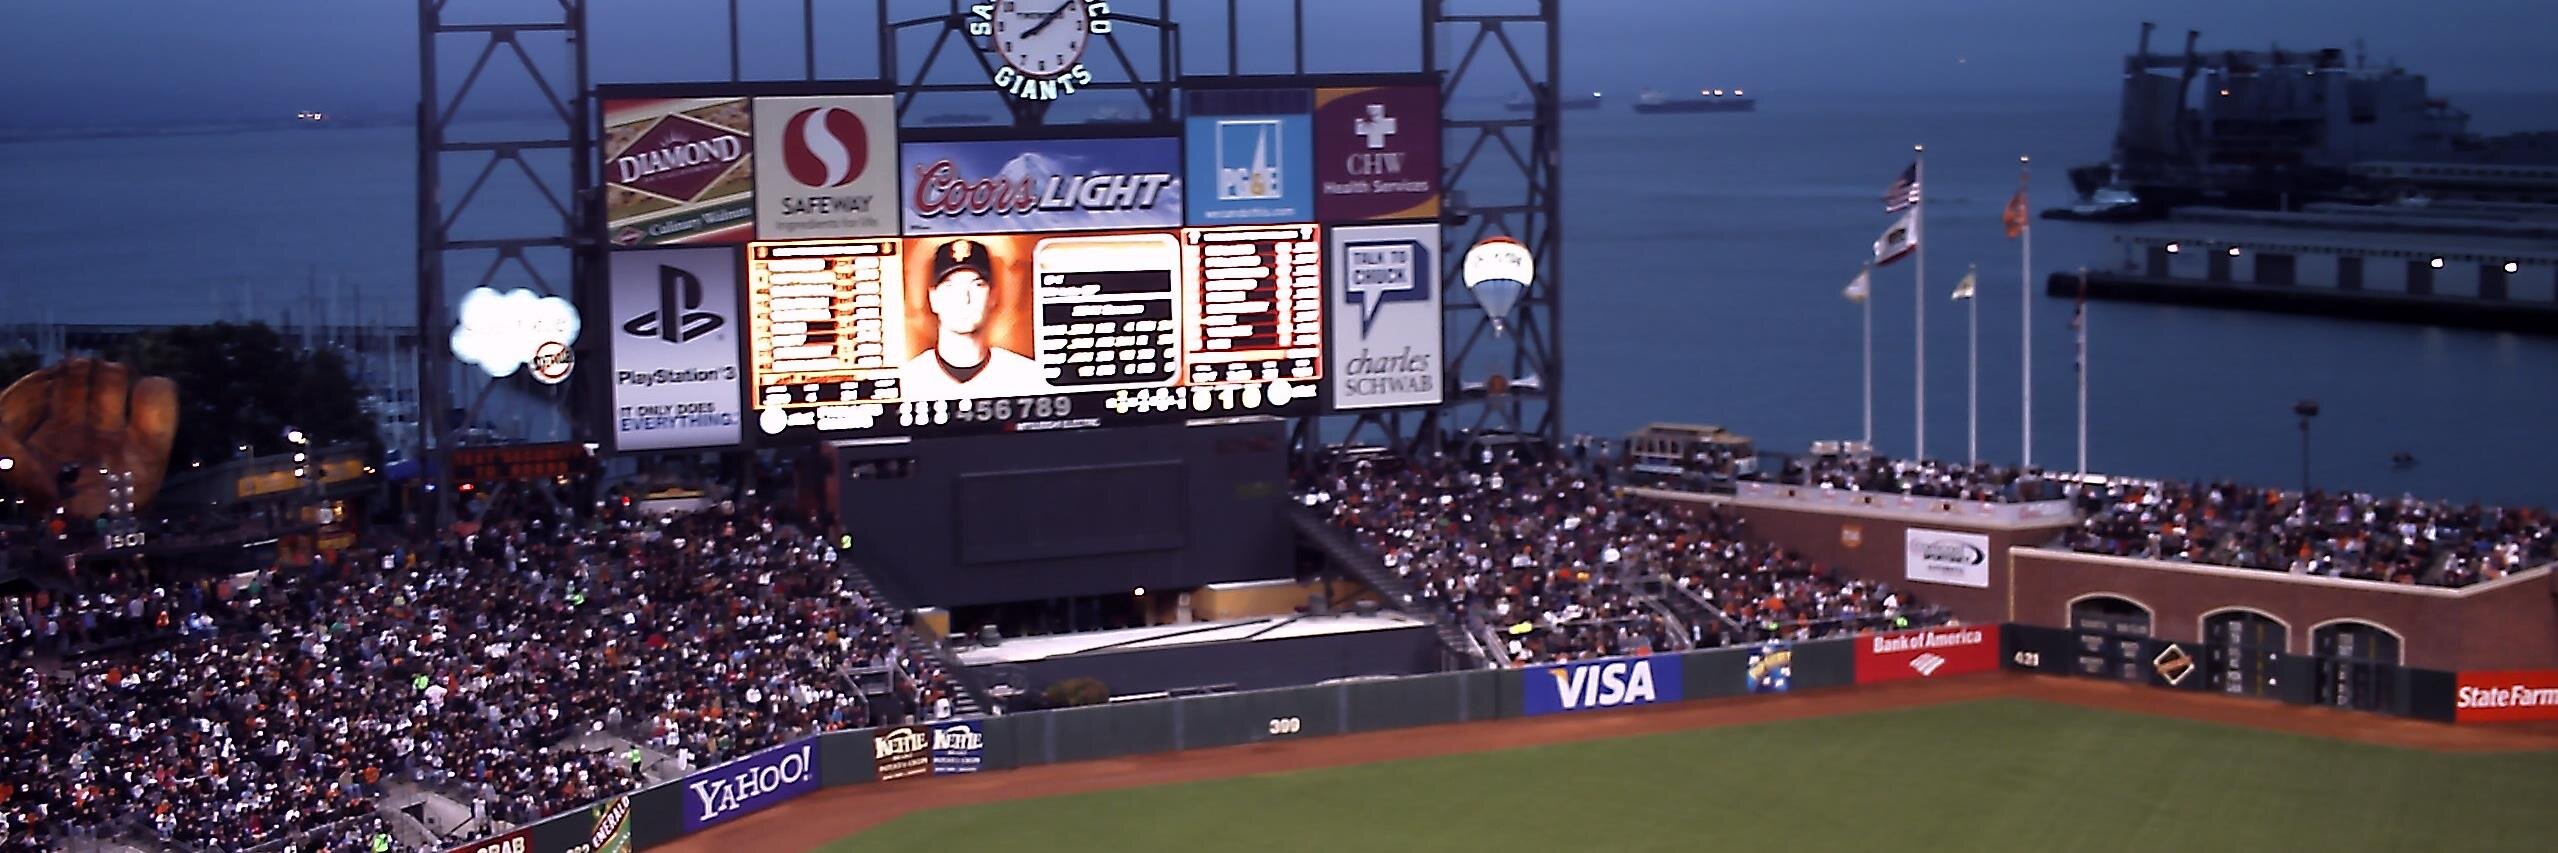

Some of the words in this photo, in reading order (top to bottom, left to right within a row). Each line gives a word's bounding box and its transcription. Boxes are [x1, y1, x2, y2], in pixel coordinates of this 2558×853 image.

[994, 65, 1092, 100] GIANTS
[619, 135, 740, 184] DIAMOND
[1346, 152, 1405, 175] CHW
[912, 159, 1041, 217] Coors
[1039, 173, 1170, 211] LIGHT
[1323, 181, 1369, 194] Health
[1373, 180, 1429, 193] Services
[782, 195, 873, 214] SAFEWAY
[1346, 346, 1430, 375] charles
[618, 368, 718, 387] PlayStation
[1345, 375, 1433, 397] SCHWAB
[638, 405, 672, 416] ONLY
[678, 402, 715, 414] DOES
[1873, 636, 1908, 653] Bank
[1910, 632, 1924, 649] of
[1925, 630, 1982, 648] America
[2014, 651, 2039, 667] 421
[1548, 660, 1656, 709] VISA
[2457, 686, 2510, 709] State
[690, 745, 811, 821] YAHOO!
[592, 795, 630, 848] EMERALD
